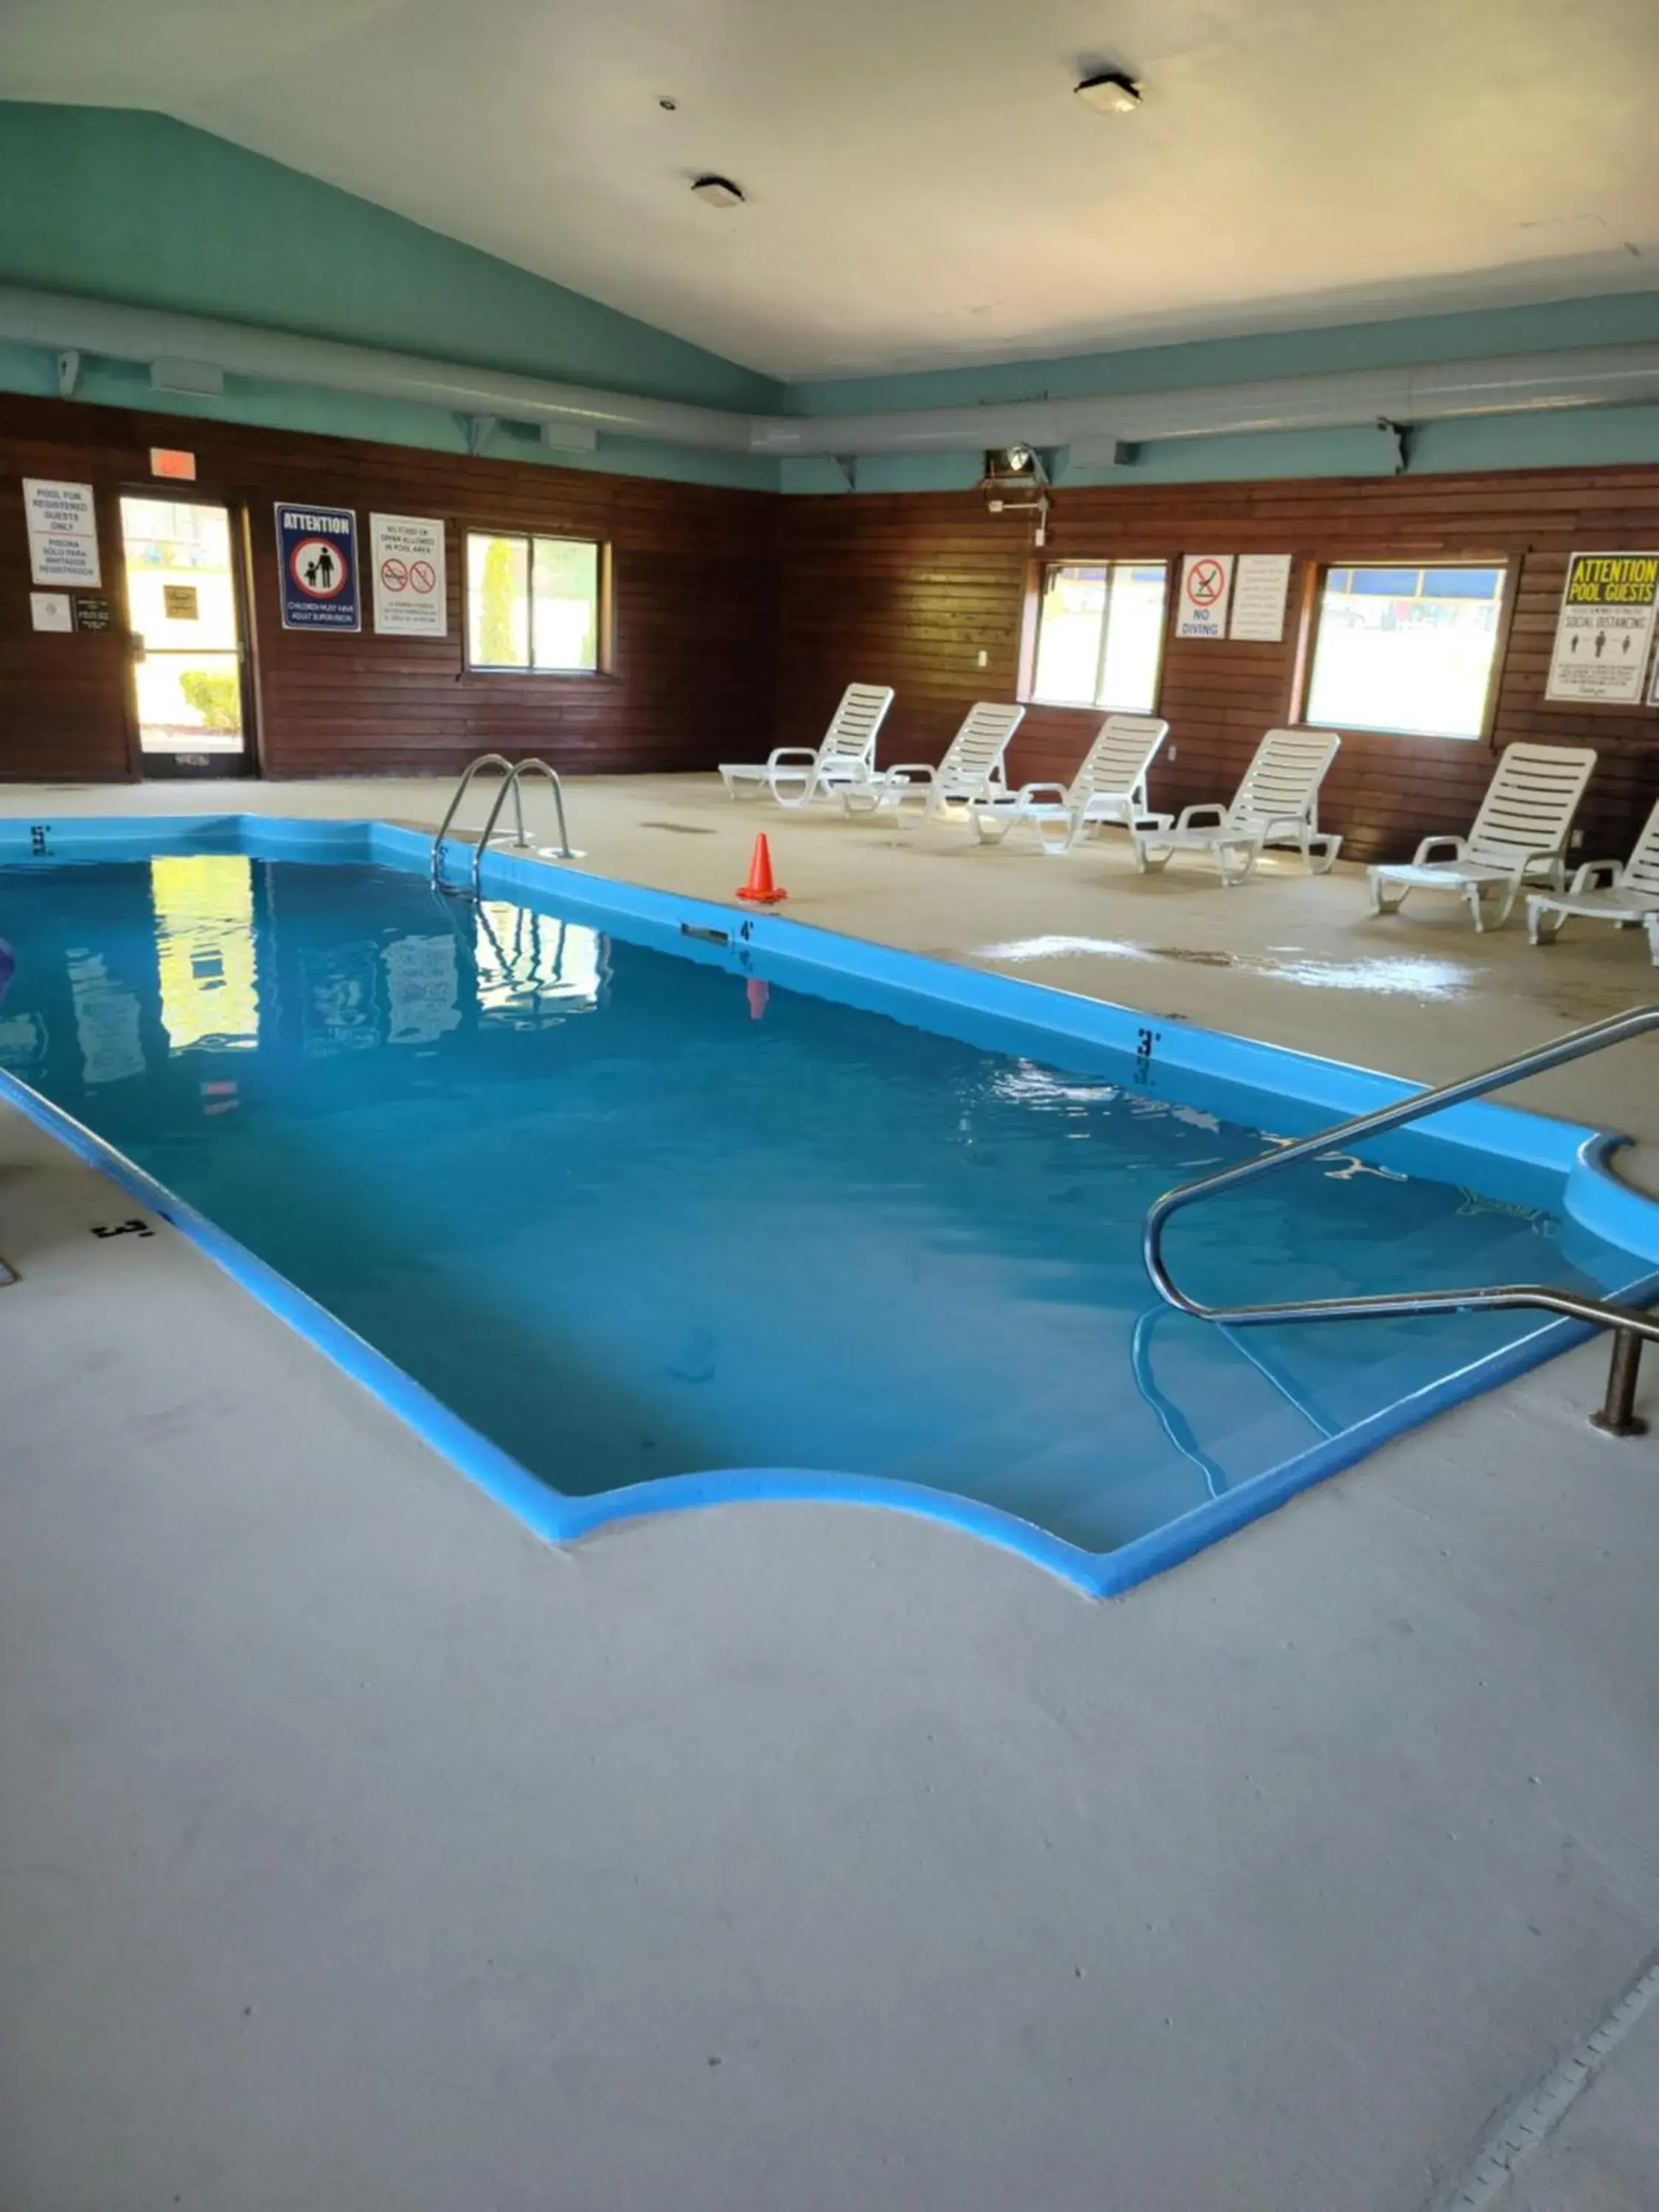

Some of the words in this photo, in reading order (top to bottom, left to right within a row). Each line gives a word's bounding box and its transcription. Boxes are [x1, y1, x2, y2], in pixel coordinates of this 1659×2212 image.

[283, 512, 350, 535] ATTENTION
[1572, 558, 1658, 582] ATTENTION
[1568, 582, 1601, 602] POOL
[1605, 583, 1654, 602] GUESTS
[1194, 609, 1210, 621] NO
[1182, 623, 1218, 634] DIVING
